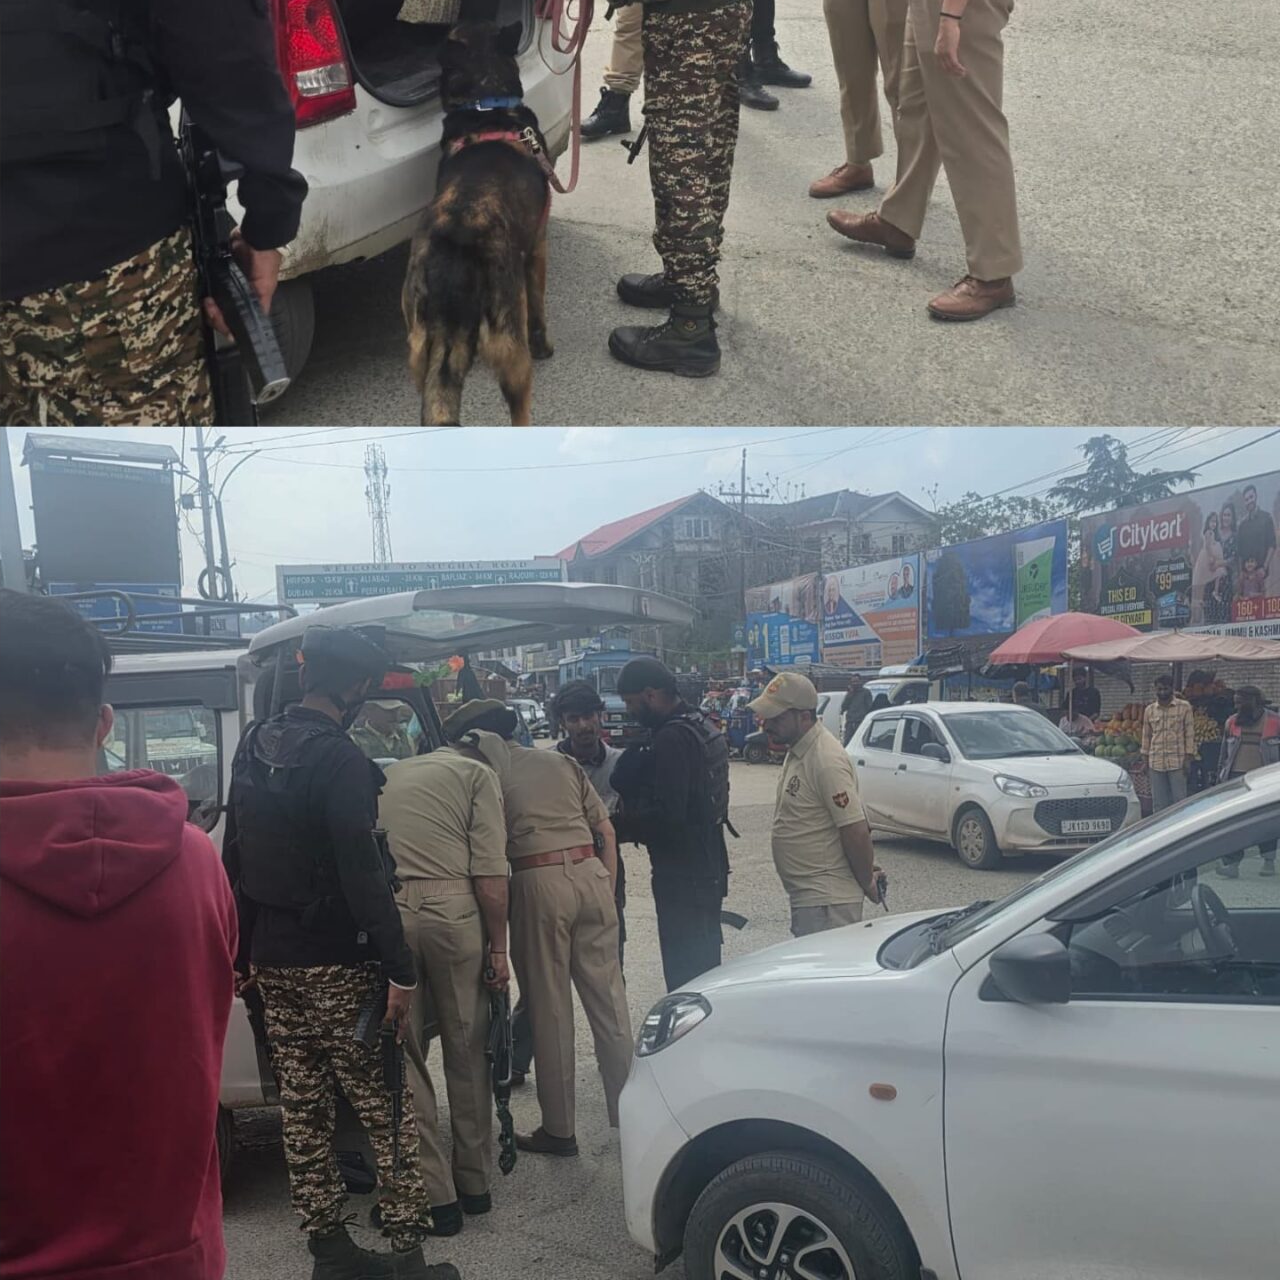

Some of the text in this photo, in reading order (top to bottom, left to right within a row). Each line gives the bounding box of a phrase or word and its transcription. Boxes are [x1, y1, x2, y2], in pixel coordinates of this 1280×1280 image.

[1119, 513, 1182, 550] Citykart
[1107, 587, 1136, 603] THIS EID
[1237, 600, 1258, 616] 160+
